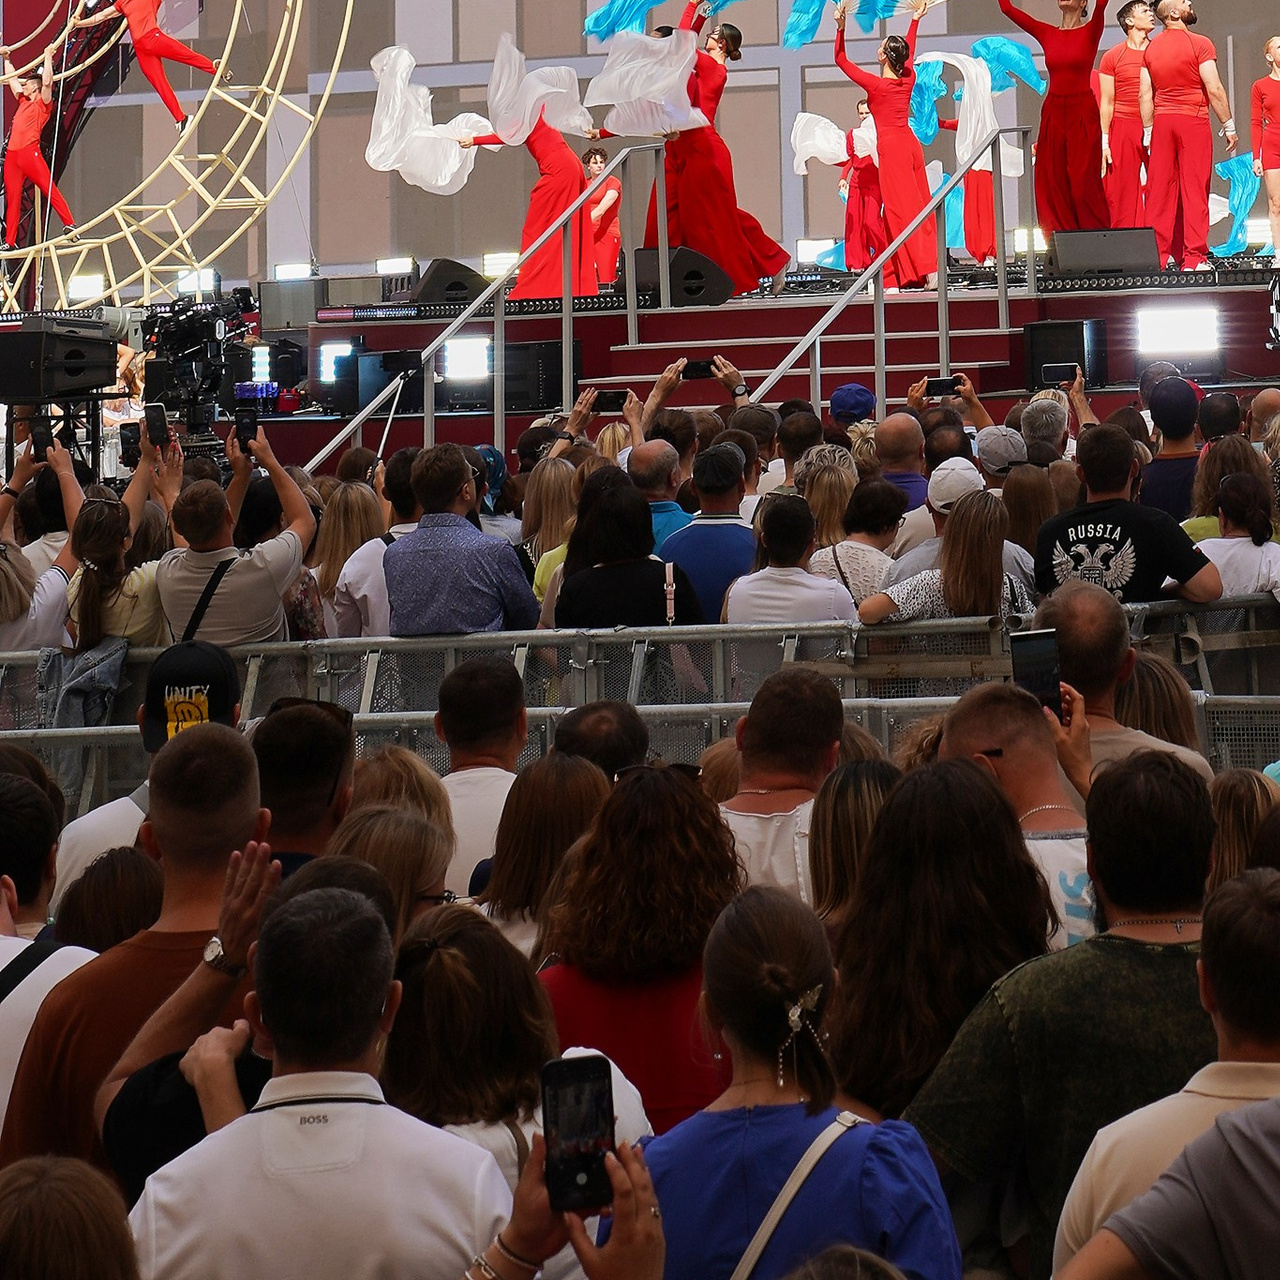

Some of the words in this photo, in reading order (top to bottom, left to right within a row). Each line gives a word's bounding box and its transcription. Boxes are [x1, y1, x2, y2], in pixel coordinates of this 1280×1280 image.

[1067, 523, 1122, 542] RUSSIA
[164, 684, 210, 702] UNITY
[299, 1114, 329, 1126] BOSS
